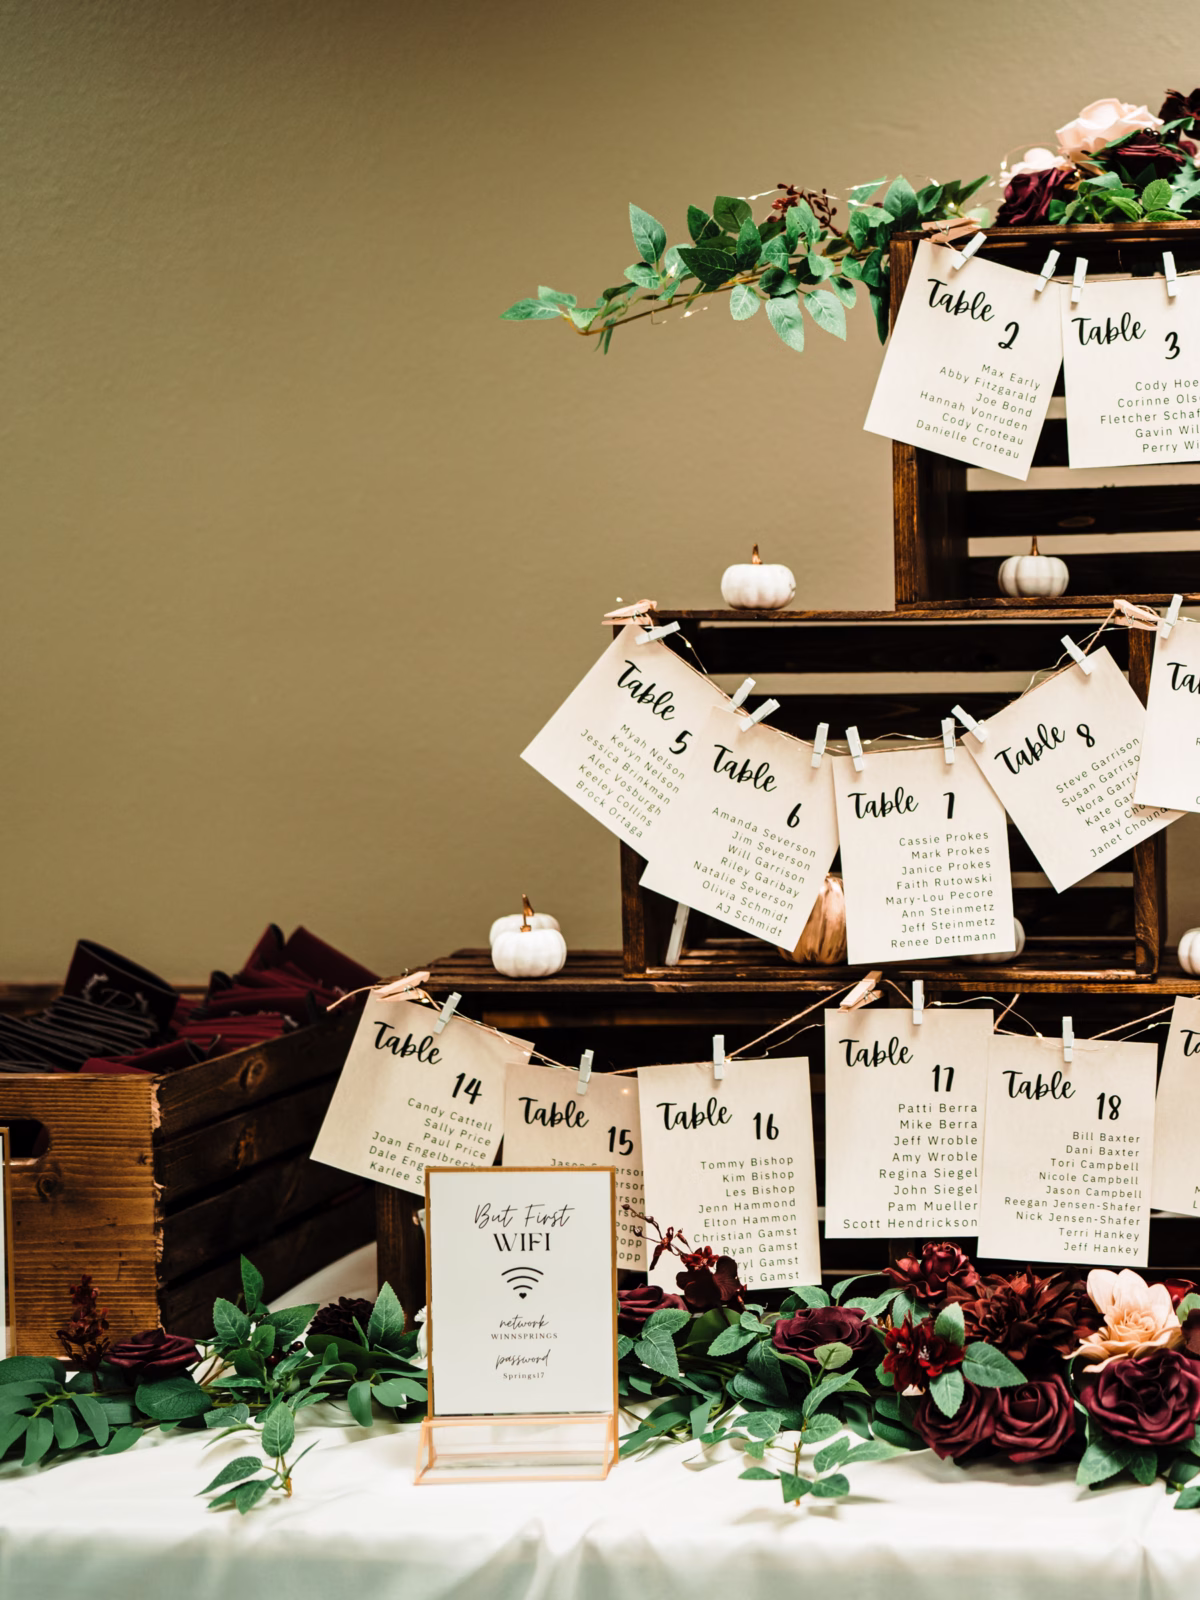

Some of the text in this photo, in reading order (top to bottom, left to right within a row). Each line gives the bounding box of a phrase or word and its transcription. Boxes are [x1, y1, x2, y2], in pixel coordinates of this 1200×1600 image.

[928, 279, 1019, 349] Table 2
[1071, 312, 1180, 359] Table 3
[939, 366, 1037, 404] Abby Fitzgarald
[1135, 380, 1168, 392] Cody
[1100, 412, 1157, 425] Fletcher
[916, 419, 1020, 459] Danielle Croteau
[617, 660, 692, 754] Table 5
[994, 724, 1095, 774] Table 8
[1055, 738, 1140, 794] Steve Garrison
[578, 764, 653, 827] Keeley Collins
[714, 745, 801, 828] Table 6
[848, 787, 918, 819] Table
[575, 780, 643, 838] Brock Ortaga
[711, 807, 816, 858] Amanda Severson
[896, 873, 992, 890] Faith Rutowski
[715, 902, 782, 937] AJ Schmidt
[890, 932, 996, 948] Renee Dettmann
[374, 1021, 482, 1104] Table 14
[839, 1037, 954, 1092] Table 17
[898, 1103, 978, 1114] Patti Berra
[1003, 1071, 1121, 1120] Table 18
[407, 1097, 493, 1132] Candy Cattell
[423, 1117, 491, 1147] Sally Price
[519, 1097, 633, 1156] Table 15
[656, 1097, 779, 1140] Table 16
[700, 1156, 794, 1170] Tommy Bishop
[474, 1203, 575, 1229] But First
[698, 1197, 796, 1214] Jenn Hammond
[1004, 1196, 1141, 1212] Reegan Jensen-Shafer
[843, 1217, 978, 1229] Scott Hendrickson
[493, 1233, 551, 1252] WIFI
[1063, 1241, 1139, 1257] Jeff Hankey
[500, 1314, 550, 1330] network
[496, 1348, 551, 1370] password
[503, 1372, 545, 1380] Springs17
